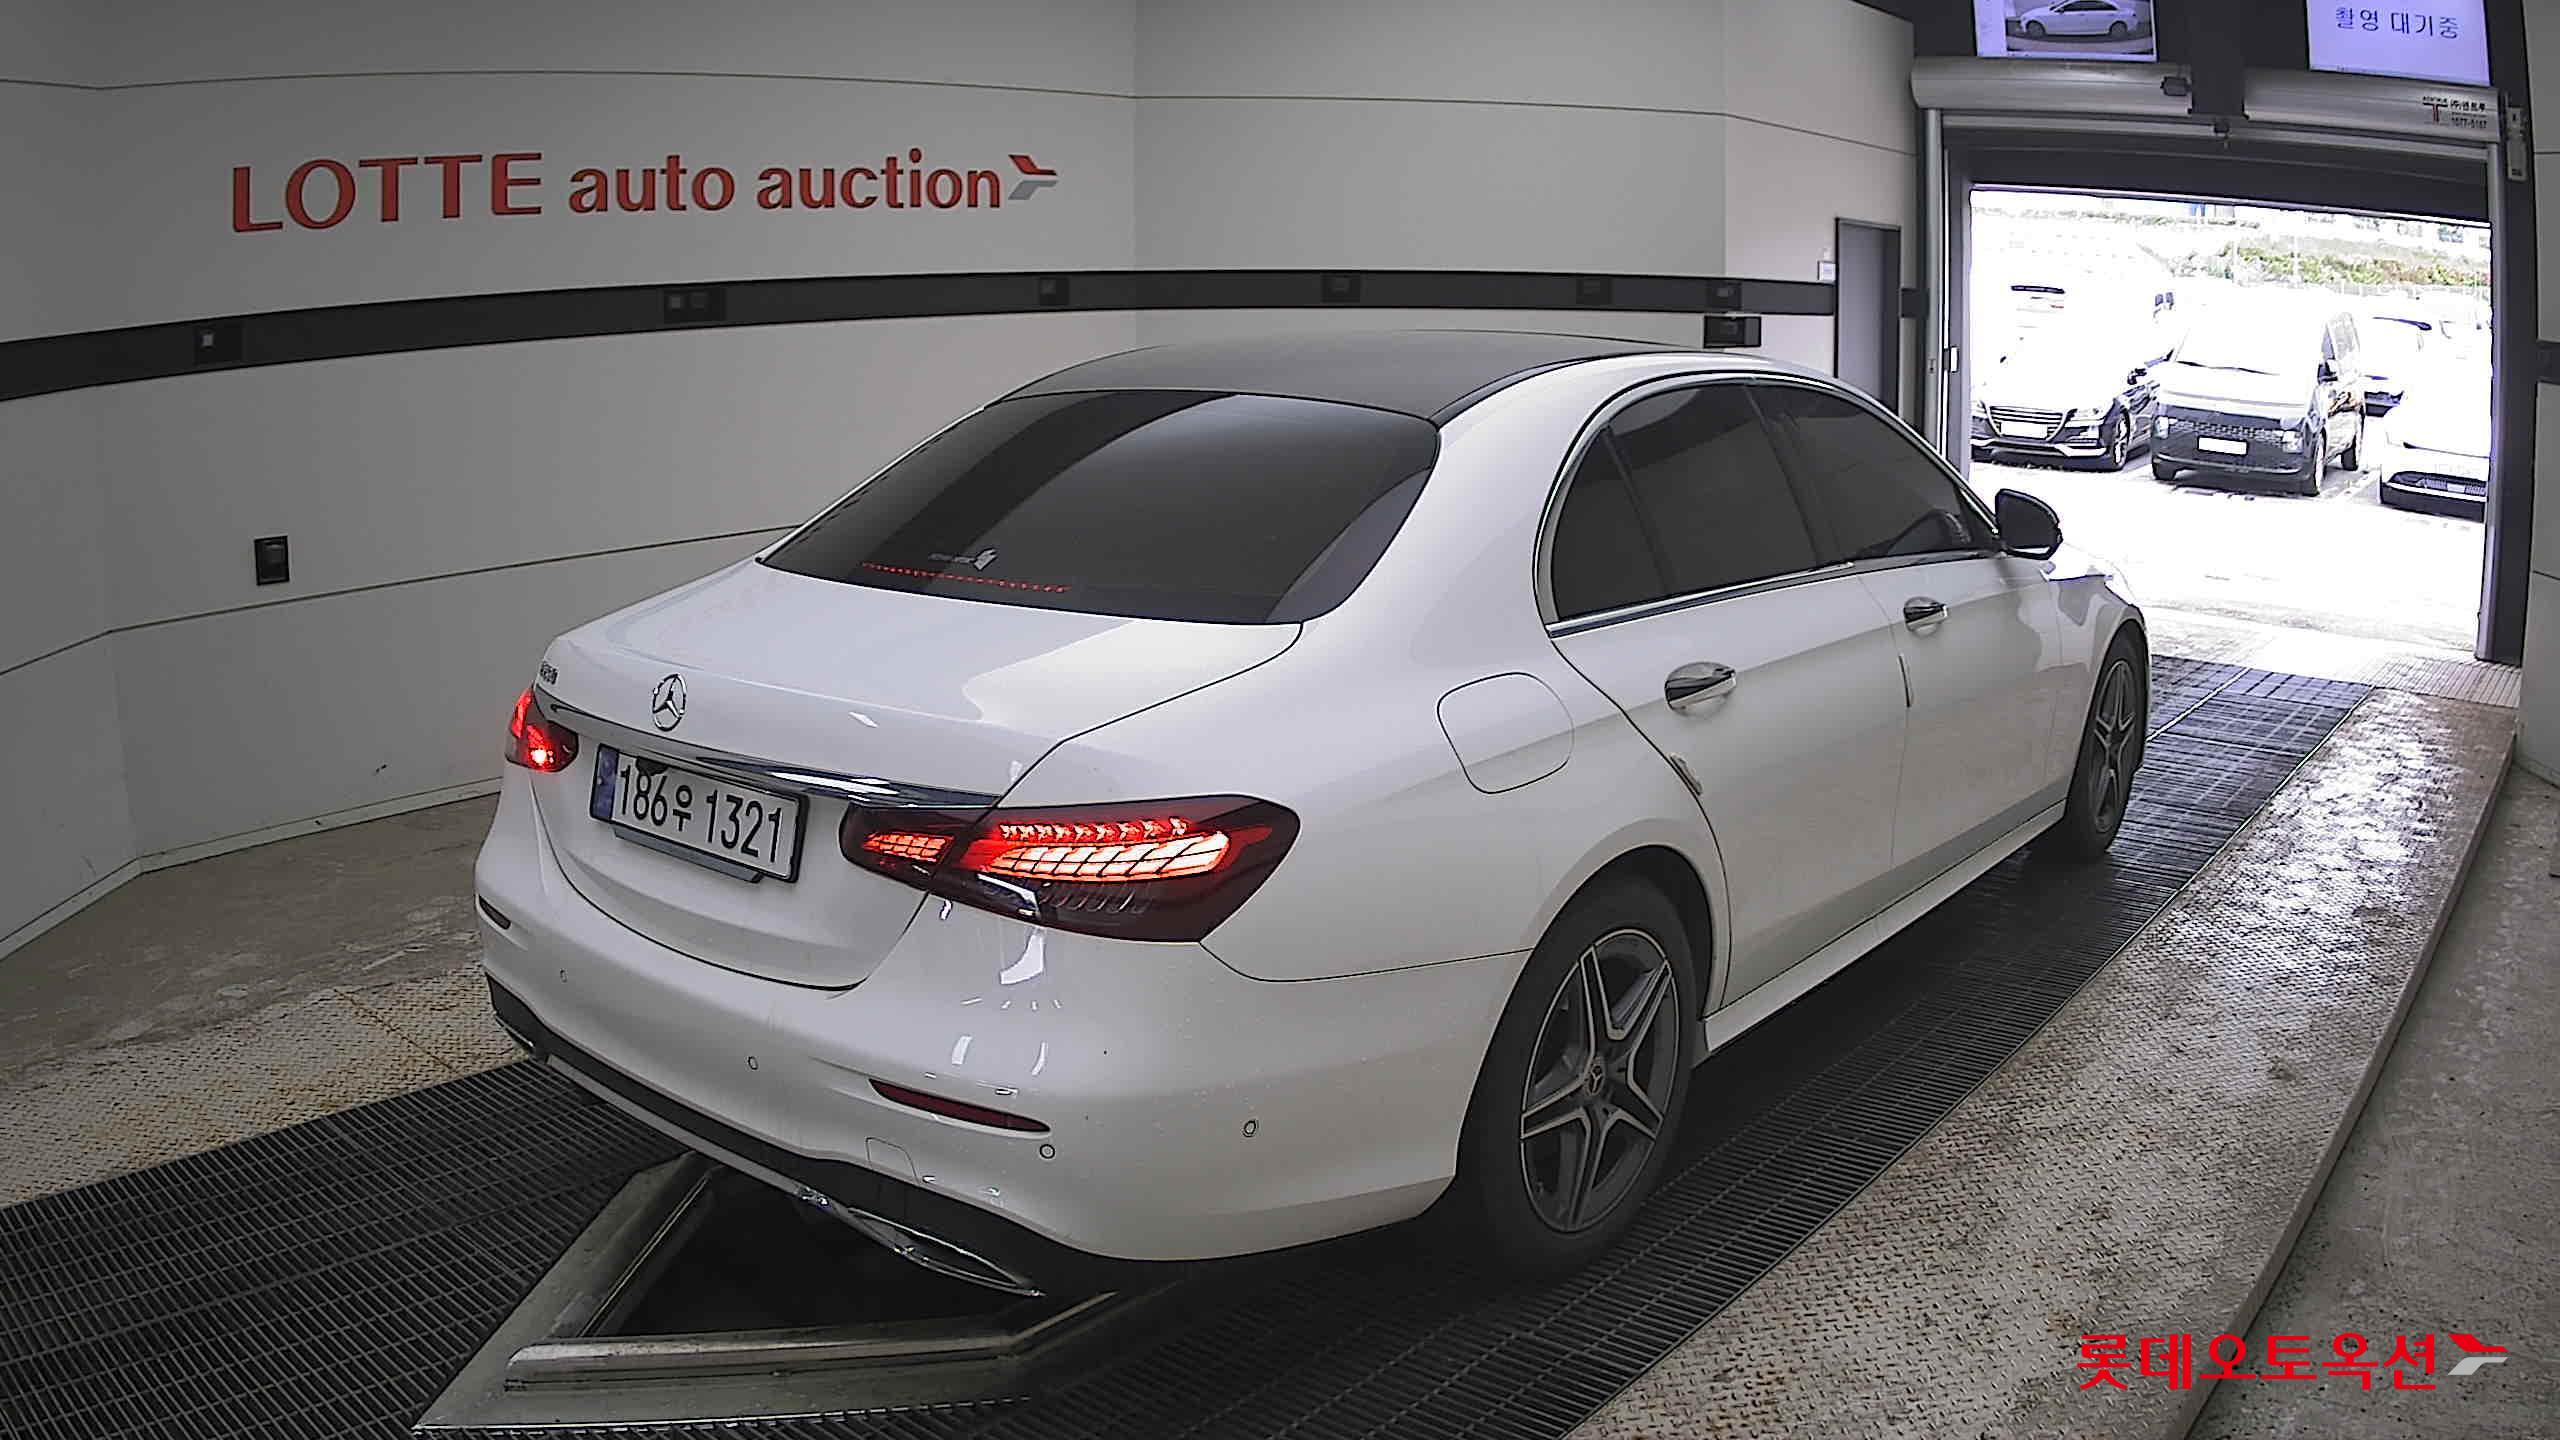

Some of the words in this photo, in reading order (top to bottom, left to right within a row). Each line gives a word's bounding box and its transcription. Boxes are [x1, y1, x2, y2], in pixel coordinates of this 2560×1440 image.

[2335, 7, 2379, 32] 촬영
[232, 152, 543, 233] LOTTE
[568, 154, 736, 214] auto
[756, 148, 1002, 210] auction
[619, 763, 694, 832] 186우
[705, 789, 783, 863] 1321
